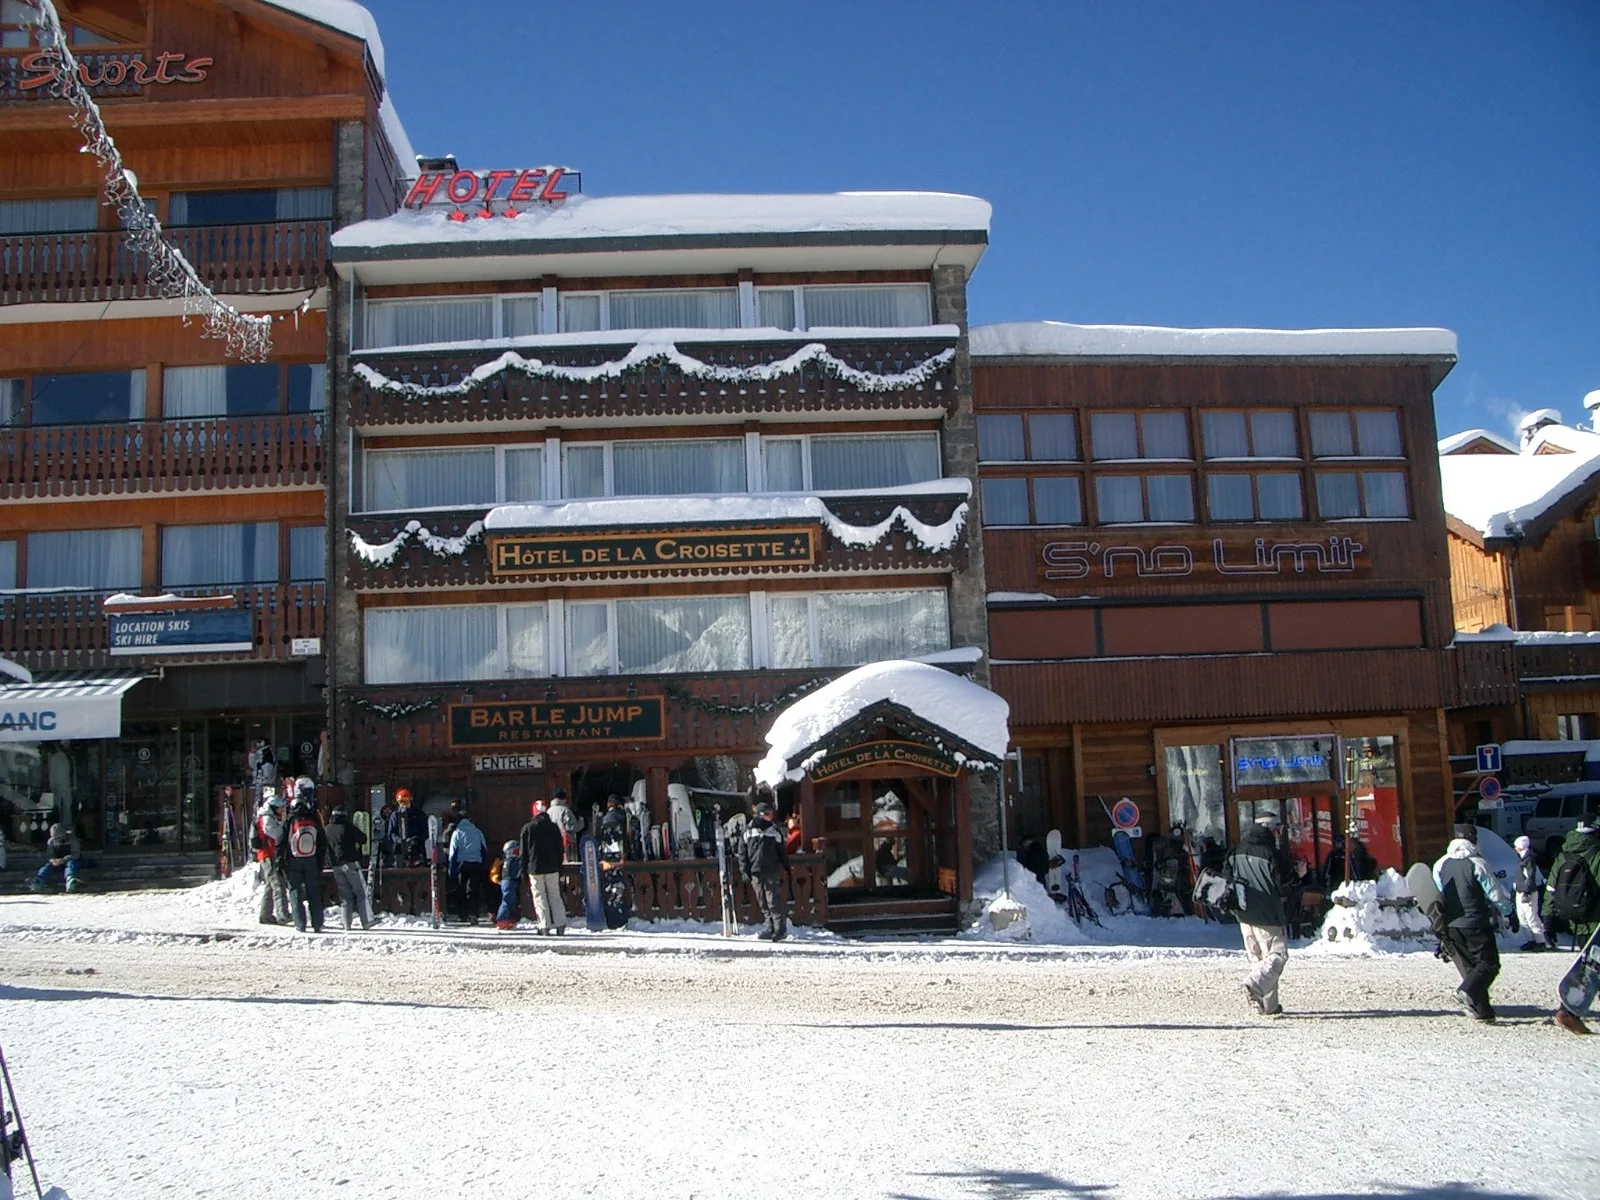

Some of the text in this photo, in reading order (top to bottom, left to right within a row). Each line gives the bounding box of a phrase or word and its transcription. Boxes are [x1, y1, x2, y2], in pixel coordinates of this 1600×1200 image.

[404, 168, 567, 208] HOTEL
[582, 547, 611, 562] DE
[616, 547, 647, 561] LA
[655, 539, 785, 560] CROISETTE
[1213, 536, 1363, 575] Limit
[115, 620, 190, 633] LOCATION SKIS
[115, 634, 158, 646] SKI HIRE
[470, 705, 643, 728] BAR LE JUMP
[499, 727, 613, 740] RESTAURANT
[857, 752, 873, 762] DE
[874, 750, 891, 760] LA
[894, 749, 952, 772] CROISETTE
